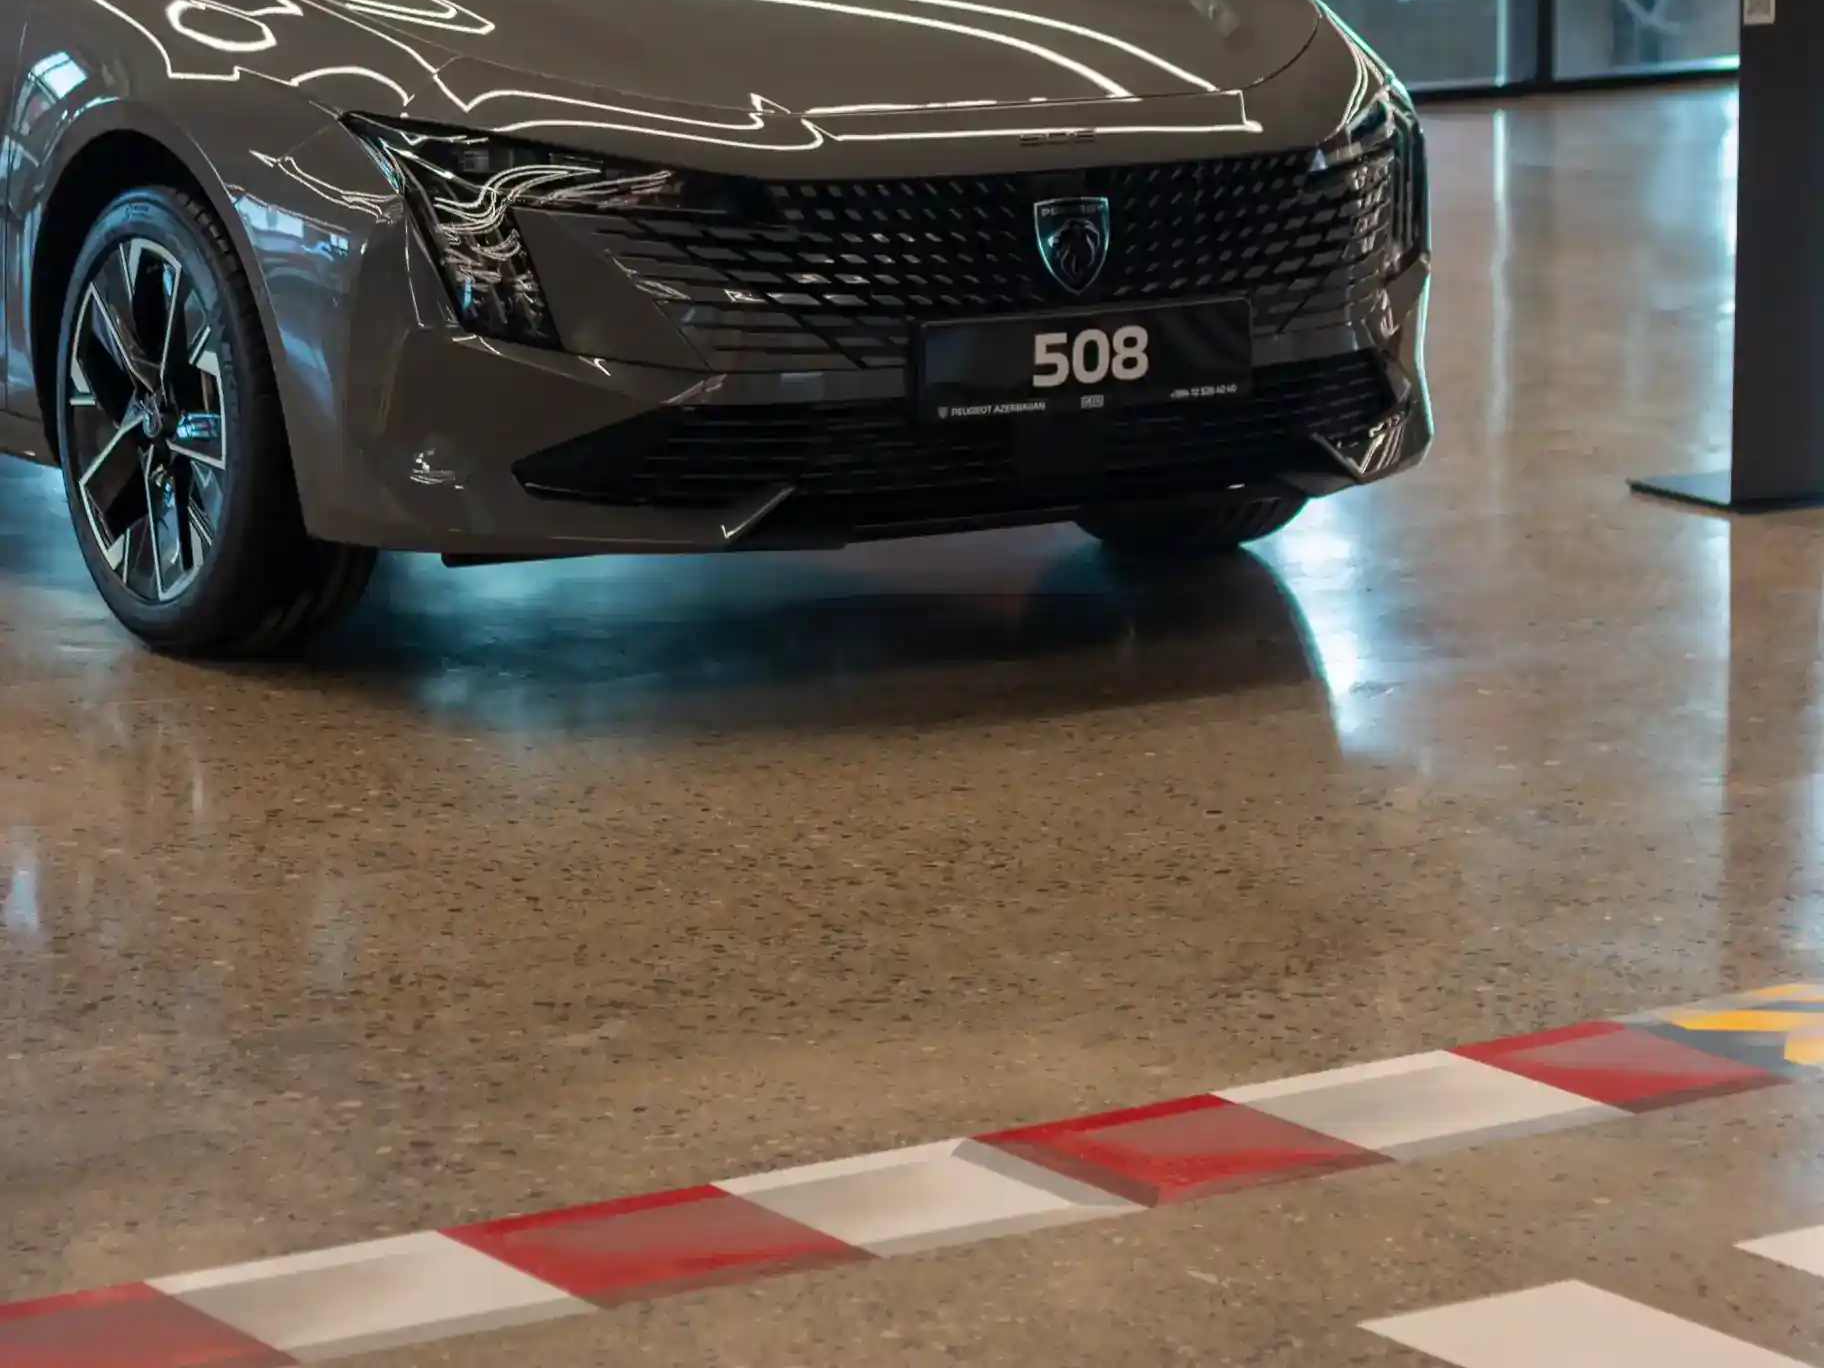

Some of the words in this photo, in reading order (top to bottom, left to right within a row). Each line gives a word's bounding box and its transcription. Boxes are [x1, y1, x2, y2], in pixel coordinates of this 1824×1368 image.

[1041, 204, 1104, 218] PEEOT
[1032, 324, 1149, 388] 508
[950, 405, 992, 417] PEUGEOT
